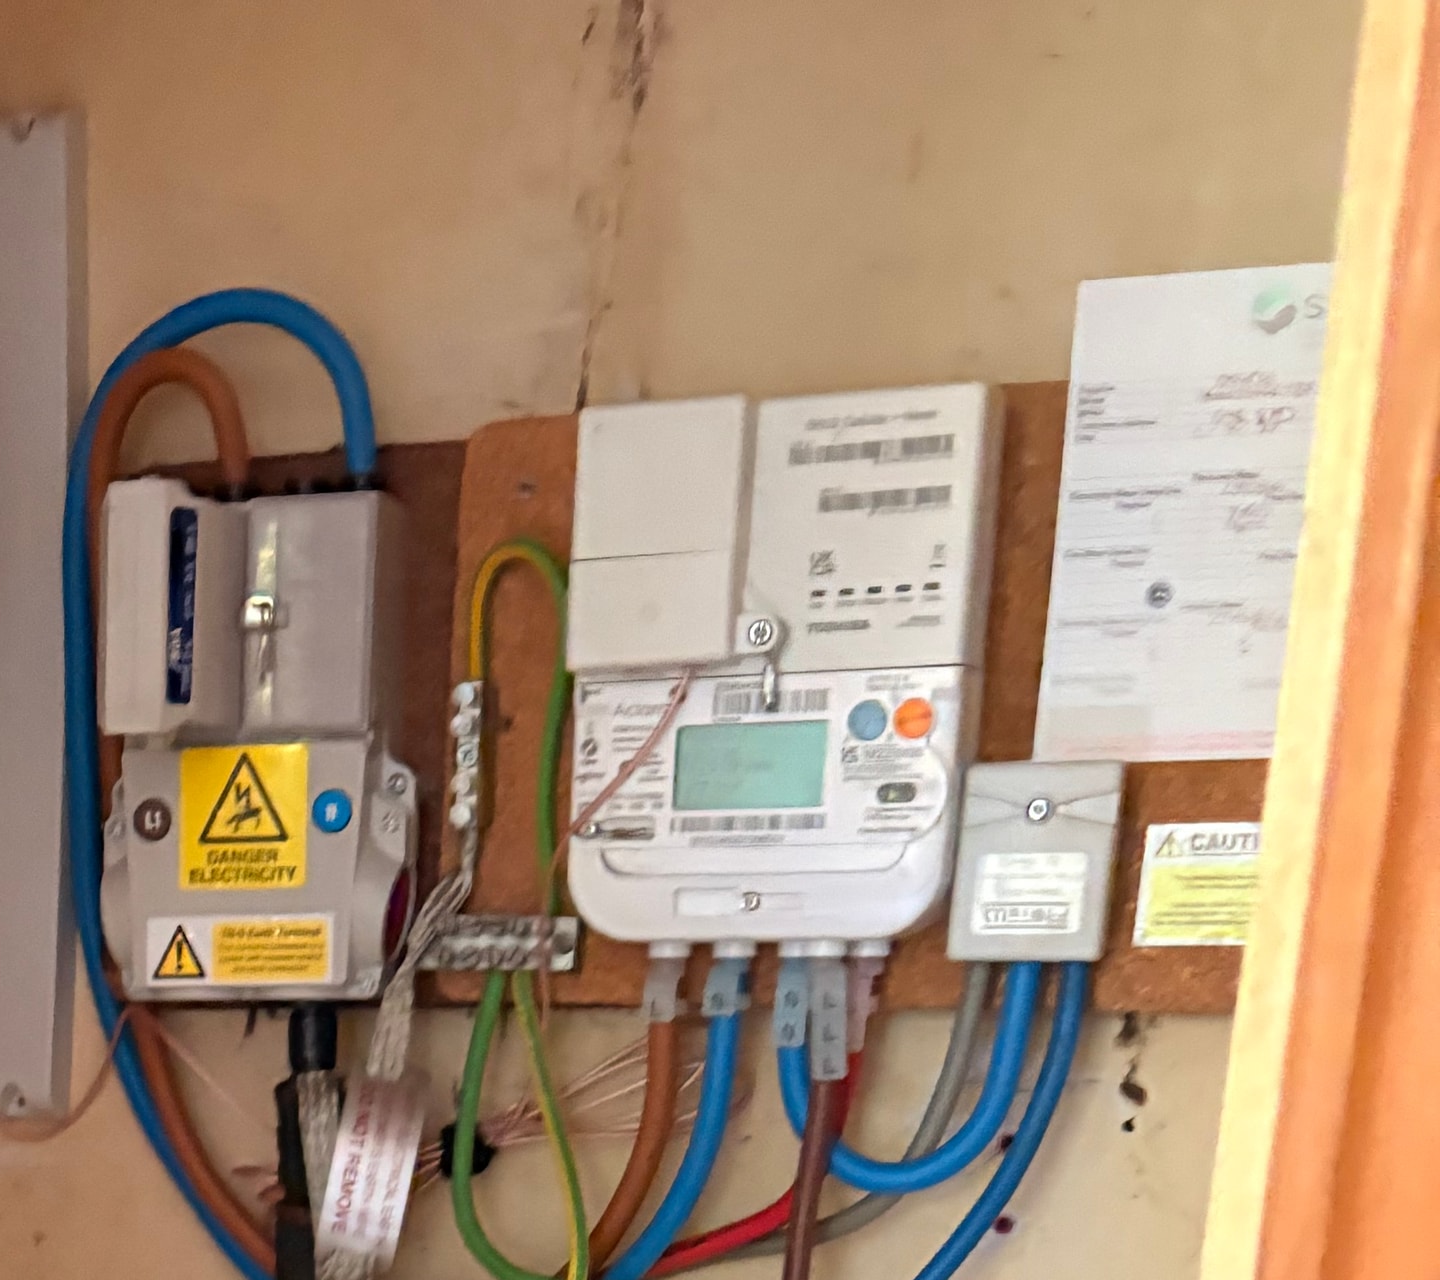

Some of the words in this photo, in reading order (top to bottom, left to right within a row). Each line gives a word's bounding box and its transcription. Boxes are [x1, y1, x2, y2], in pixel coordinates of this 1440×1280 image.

[1191, 831, 1261, 852] CAUTI
[207, 848, 279, 866] DANGER
[189, 865, 297, 884] ELECTRICITY
[332, 1153, 361, 1234] REMOVE
